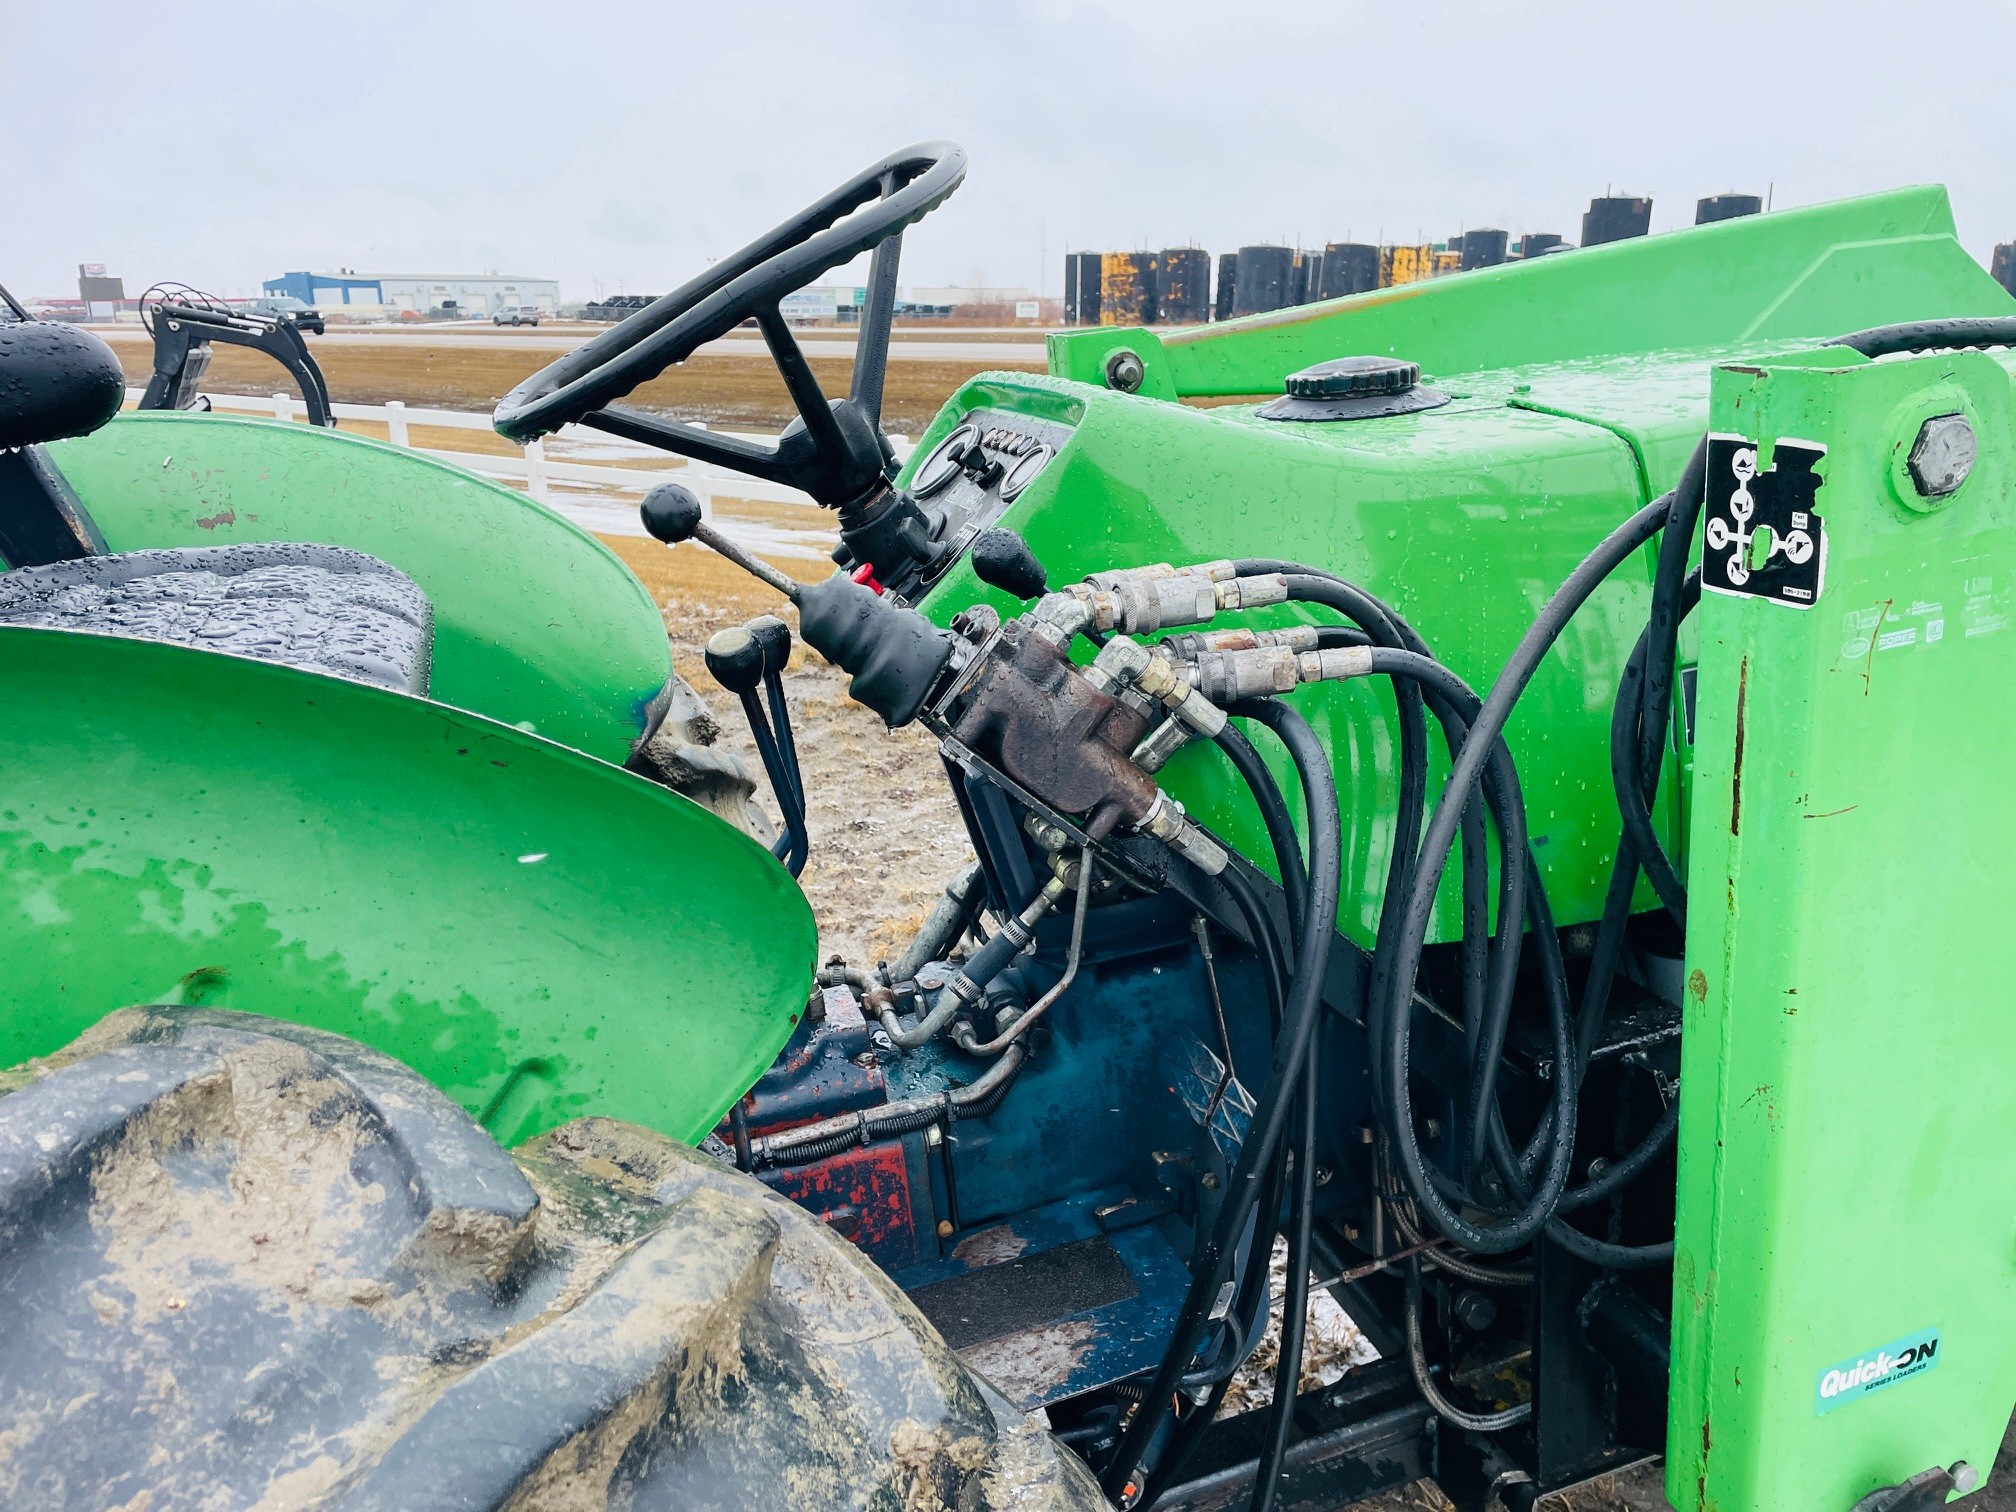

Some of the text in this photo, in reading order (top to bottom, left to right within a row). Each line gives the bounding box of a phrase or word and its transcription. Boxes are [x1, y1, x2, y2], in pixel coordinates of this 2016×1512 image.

[1878, 631, 1916, 647] ROPER
[1864, 1362, 1928, 1391] SERIES LOADERS
